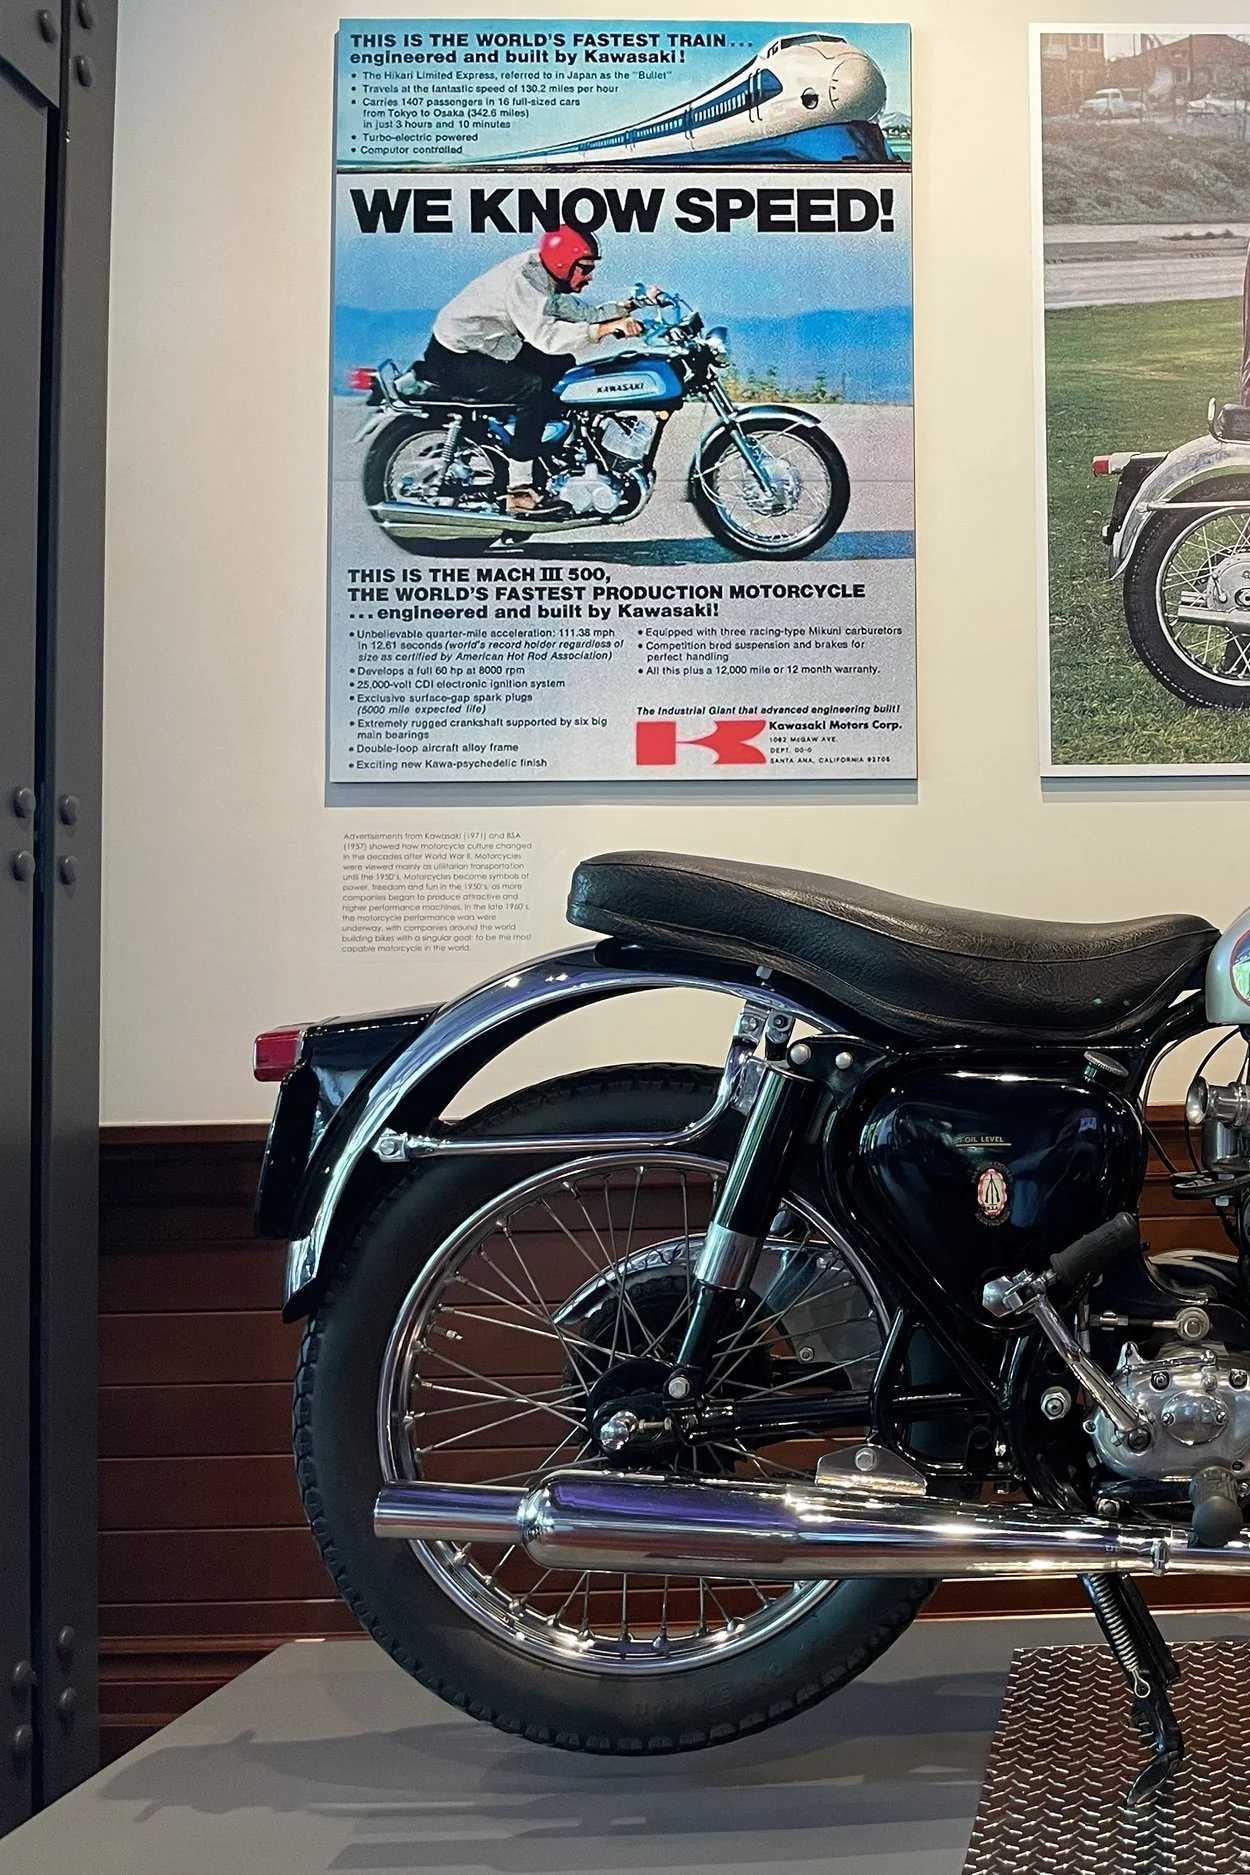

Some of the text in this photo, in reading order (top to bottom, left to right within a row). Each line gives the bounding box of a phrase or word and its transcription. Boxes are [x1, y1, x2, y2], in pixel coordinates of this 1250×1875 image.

[350, 33, 396, 48] THIS
[403, 33, 423, 47] IS
[429, 33, 469, 47] THE
[476, 33, 566, 48] WORLD'S
[572, 33, 661, 47] FASTEST
[349, 49, 685, 66] engineered and built by Kawasaki!
[362, 70, 672, 81] The Hikari Limited Express, referred to in Japan as the "Bullet"
[362, 83, 619, 94] Travels at the fantastic speed of 130.2 miles per hour
[362, 97, 581, 109] Carries 1407 passengers in 16 full-sized cars
[363, 108, 530, 120] from Tokyo to Osaka (342.6 miles)
[362, 119, 511, 130] in just 3 hours and 10 minutes
[362, 132, 479, 142] Turbo-electric powered
[351, 188, 894, 233] WE KNOW SPEED!
[597, 383, 644, 393] KAWASAKI
[347, 568, 395, 583] THIS
[401, 568, 422, 583] IS
[428, 567, 470, 582] THE
[476, 567, 535, 582] MACH
[568, 567, 611, 583] 500,
[347, 583, 865, 602] THE WORLD'S FASTEST PRODUCTION MOTORCYCLE
[494, 604, 531, 619] and
[537, 604, 582, 618] built
[587, 604, 611, 621] by
[617, 603, 719, 618] Kawasaki!
[645, 626, 903, 638] Equipped with three racing-type Mikuni carburetors
[645, 639, 865, 651] Competition bred suspension and brakes for
[646, 652, 729, 663] perfect handling
[356, 679, 566, 690] 25,000-volt CDI electronic ignition system
[637, 704, 900, 716] The Industrial Giant that advanced engineering built!
[357, 716, 608, 729] Extremely rugged crankshaft supported by six big
[768, 719, 902, 731] Kawasaki Motors Corp.
[356, 730, 430, 741] main bearings
[356, 758, 548, 770] Exciting new Kawa-psychedelic finish
